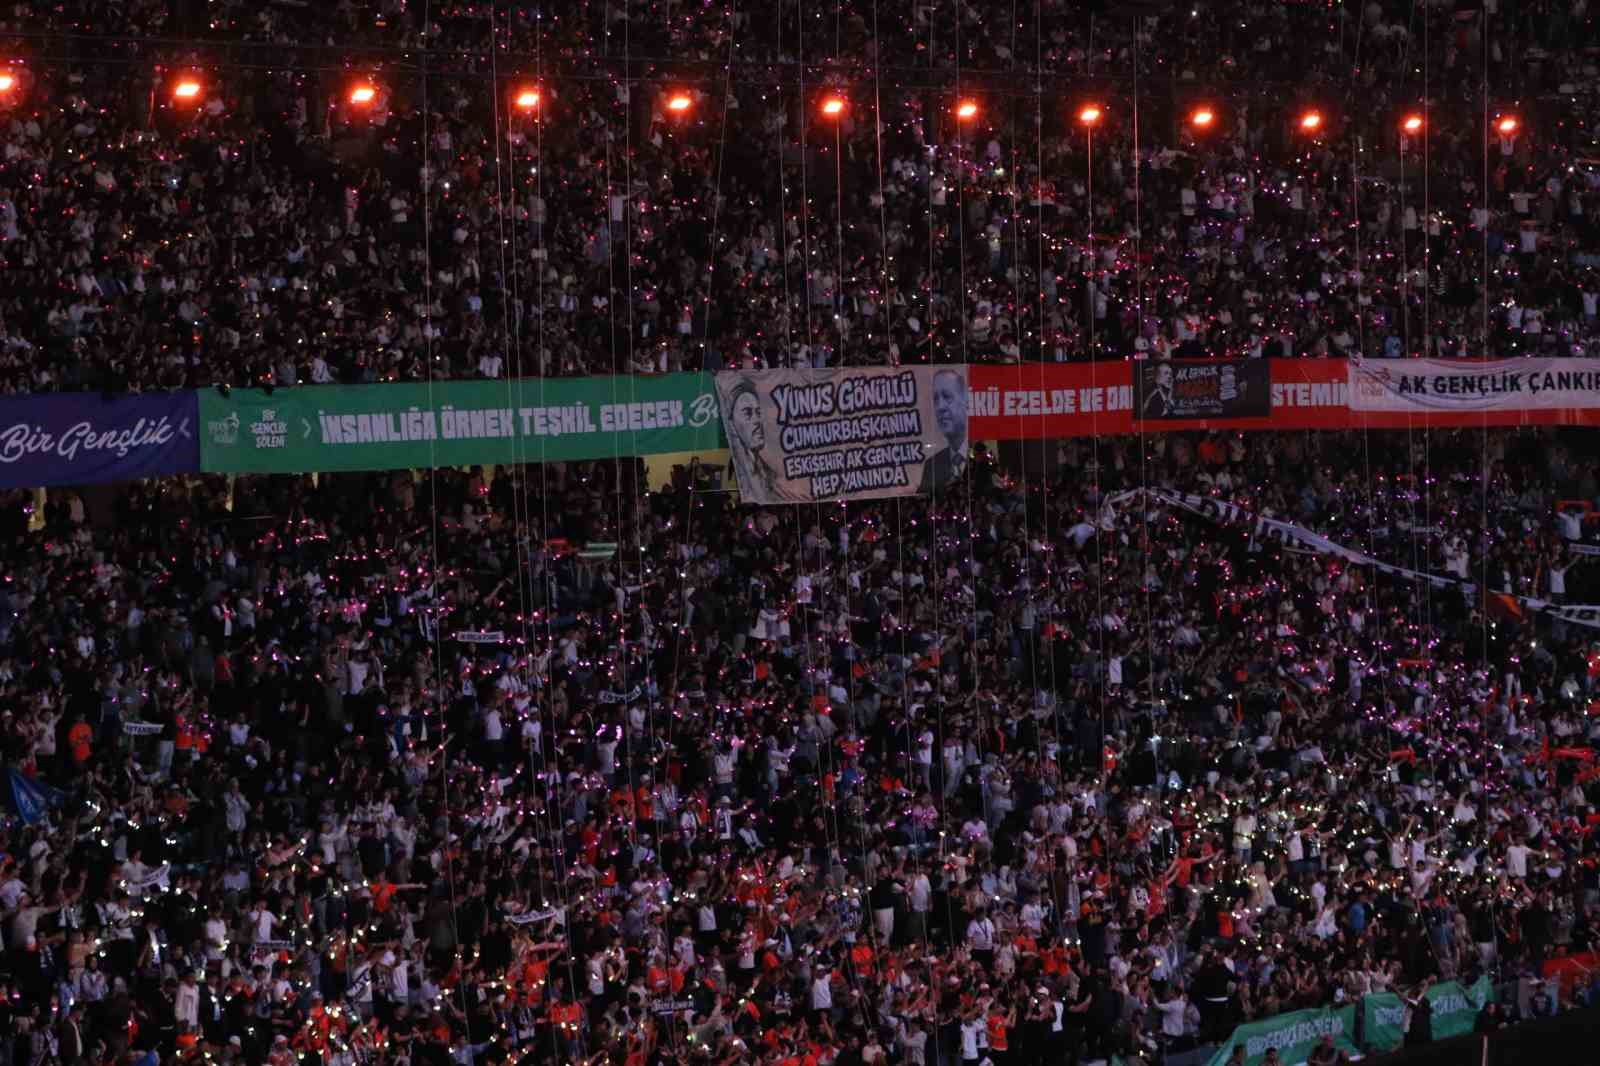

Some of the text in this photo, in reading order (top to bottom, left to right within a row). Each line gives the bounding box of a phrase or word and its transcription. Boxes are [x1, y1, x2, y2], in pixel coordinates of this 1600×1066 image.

[772, 373, 917, 424] YUNUS GÖNÜLLÜ
[1003, 389, 1077, 416] EZELDE
[1079, 387, 1105, 413] VE
[1398, 374, 1427, 395] AK
[1433, 371, 1521, 397] GENÇLİK
[0, 423, 55, 463] Bir
[57, 415, 176, 461] Gençlik
[320, 400, 684, 444] İNSANLIĞA ÖRNEK TEŞKİL EDECEK
[781, 411, 920, 451] CUMHURBAŞKANIM
[846, 449, 864, 468] AK
[811, 466, 908, 497] HEP YANINDA
